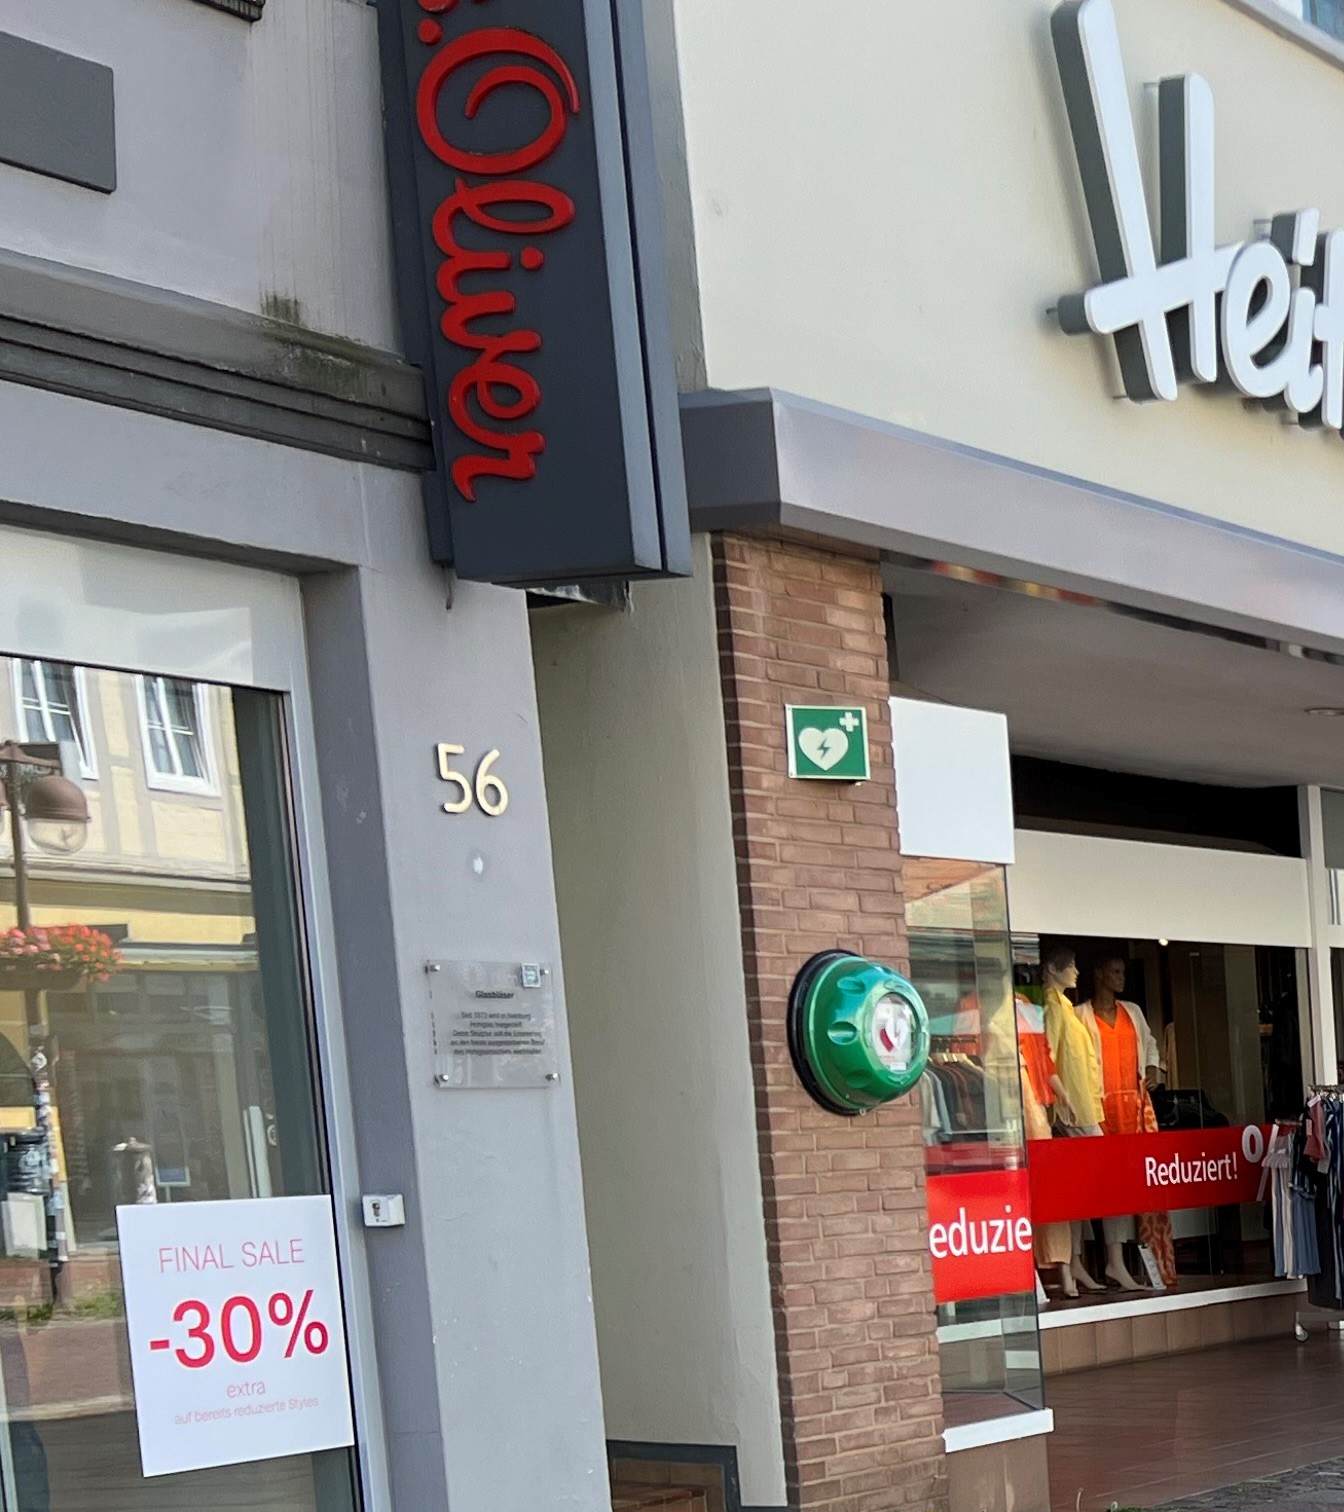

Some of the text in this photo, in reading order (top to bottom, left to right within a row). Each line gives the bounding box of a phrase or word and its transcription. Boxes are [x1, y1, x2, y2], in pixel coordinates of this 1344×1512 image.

[415, 0, 581, 503] .Oliver
[437, 743, 509, 816] 56
[1144, 1151, 1238, 1187] Reduziert!
[159, 1238, 305, 1273] FINAL SALE
[150, 1289, 329, 1368] -30%
[226, 1381, 266, 1398] extra
[174, 1397, 320, 1425] auf bereits reduzierte Styles
